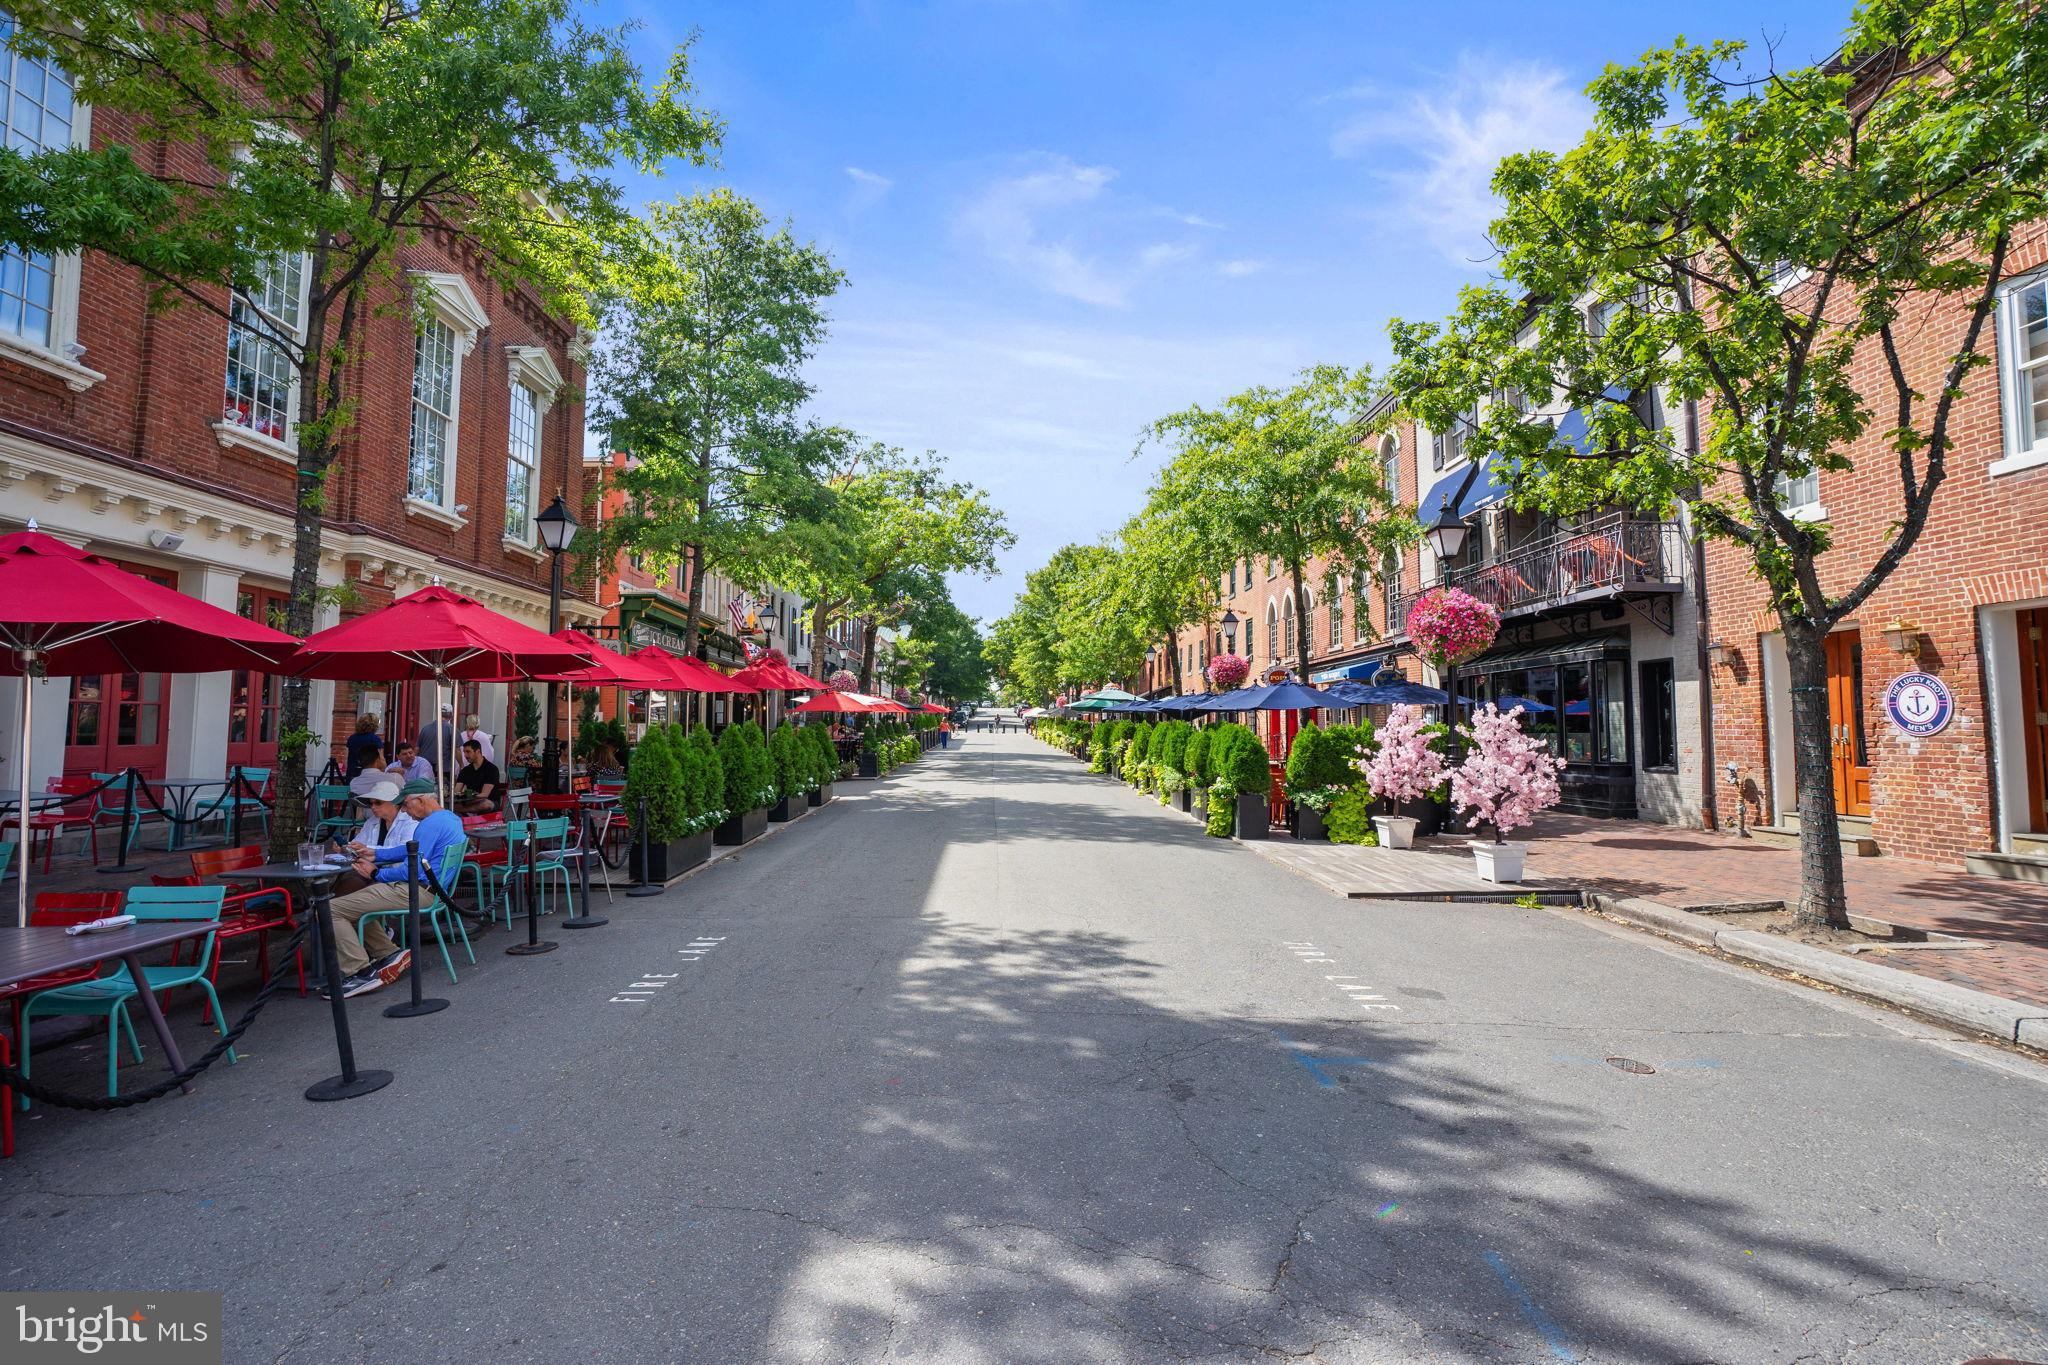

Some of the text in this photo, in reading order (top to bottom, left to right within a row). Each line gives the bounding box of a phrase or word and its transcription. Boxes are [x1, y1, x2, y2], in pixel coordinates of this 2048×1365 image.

[649, 631, 662, 645] ICE
[1890, 685, 1902, 698] THE
[1899, 676, 1926, 687] LUCKY
[1907, 723, 1933, 732] MEN'S
[608, 936, 728, 1003] FIRE LANE
[1283, 941, 1402, 1010] FIRE LANE
